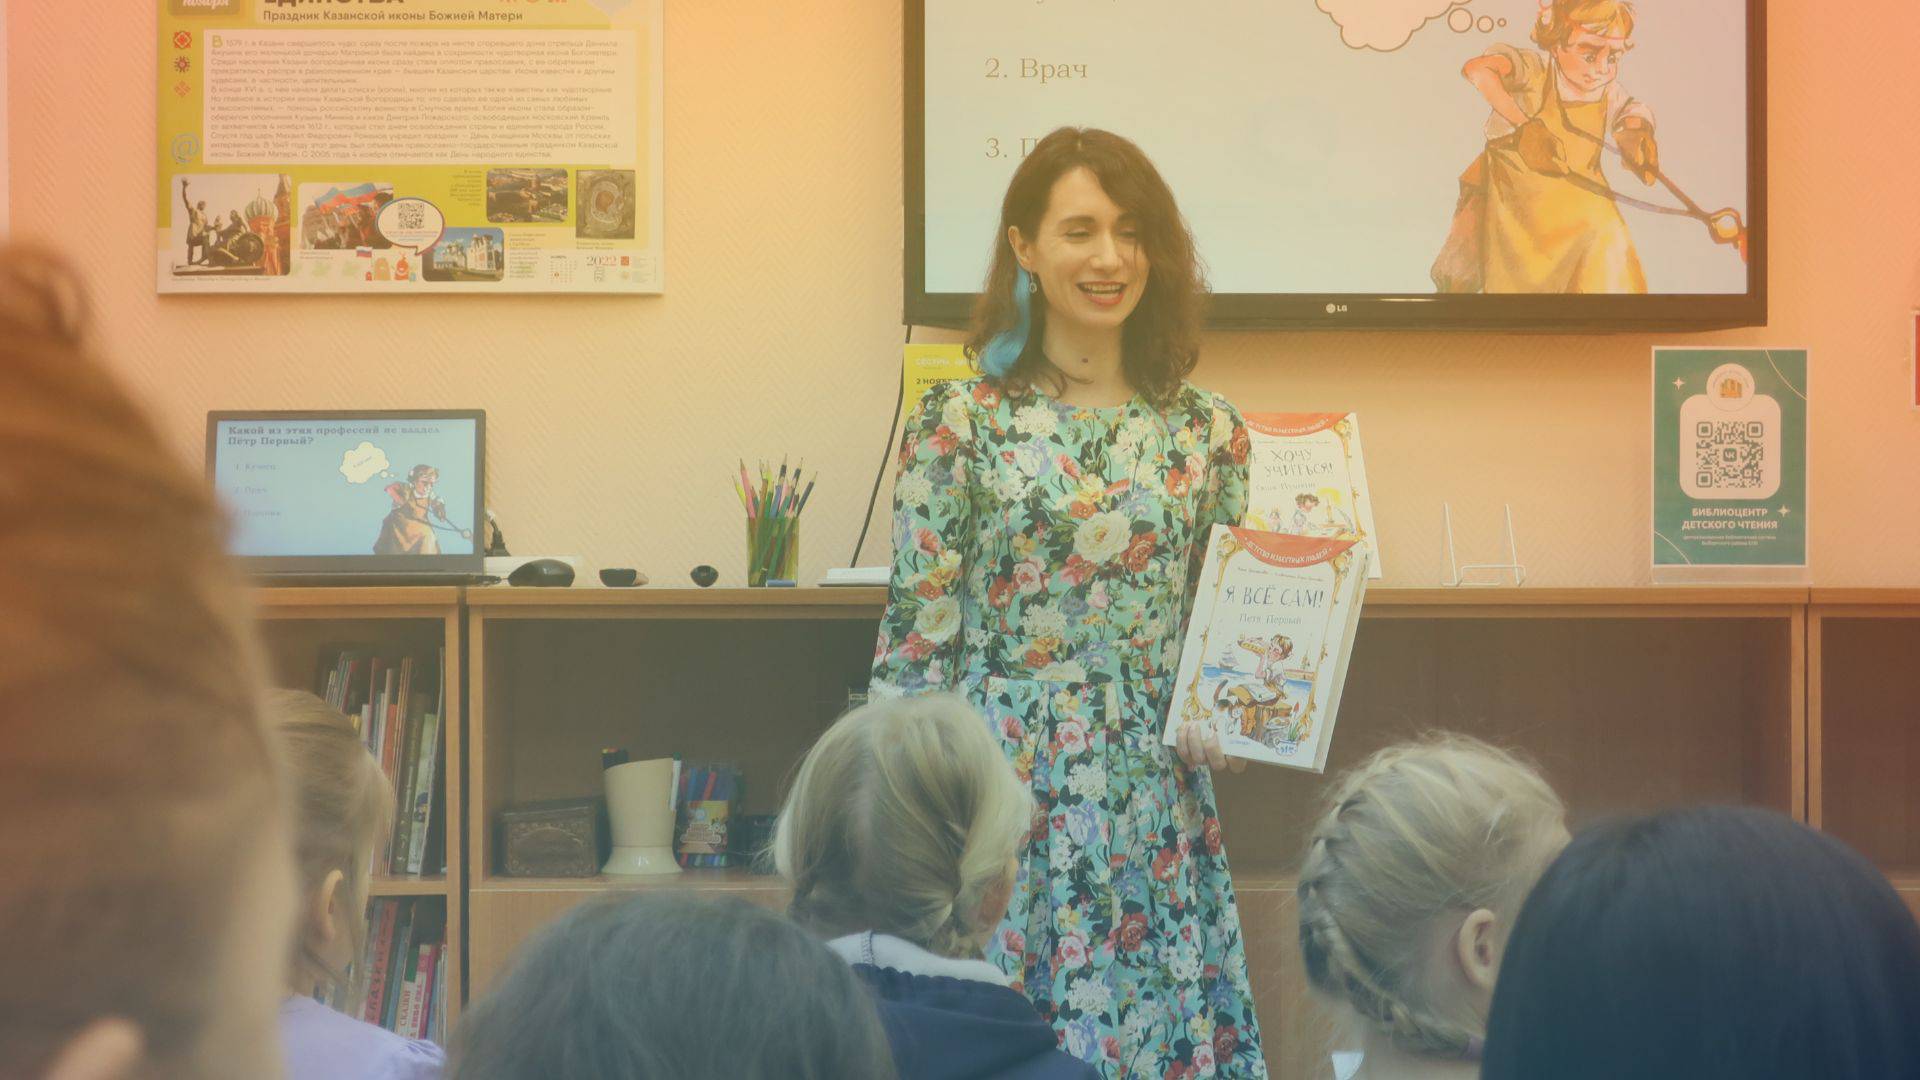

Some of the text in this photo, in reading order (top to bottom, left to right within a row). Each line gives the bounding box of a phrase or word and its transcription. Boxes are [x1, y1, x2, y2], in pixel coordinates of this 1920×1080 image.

[263, 10, 523, 21] Праздник Казанской иконы Божией Матери
[985, 57, 1088, 84] 2. Врач
[985, 137, 1008, 158] 3.
[586, 256, 617, 267] 2022
[1337, 304, 1348, 313] LG
[228, 426, 264, 435] Какой
[317, 426, 380, 437] профессий
[1270, 448, 1312, 462] ХОЧУ
[1264, 462, 1336, 478] УЧИТЬСЯ!
[1691, 508, 1768, 518] БИБЛИОЦЕНТР
[1681, 520, 1778, 530] ДЕТСКОГО ЧТЕНИЯ
[1270, 553, 1305, 563] ИЗВЕСТНЫХ
[1225, 584, 1324, 608] Я ВСЁ САМ!
